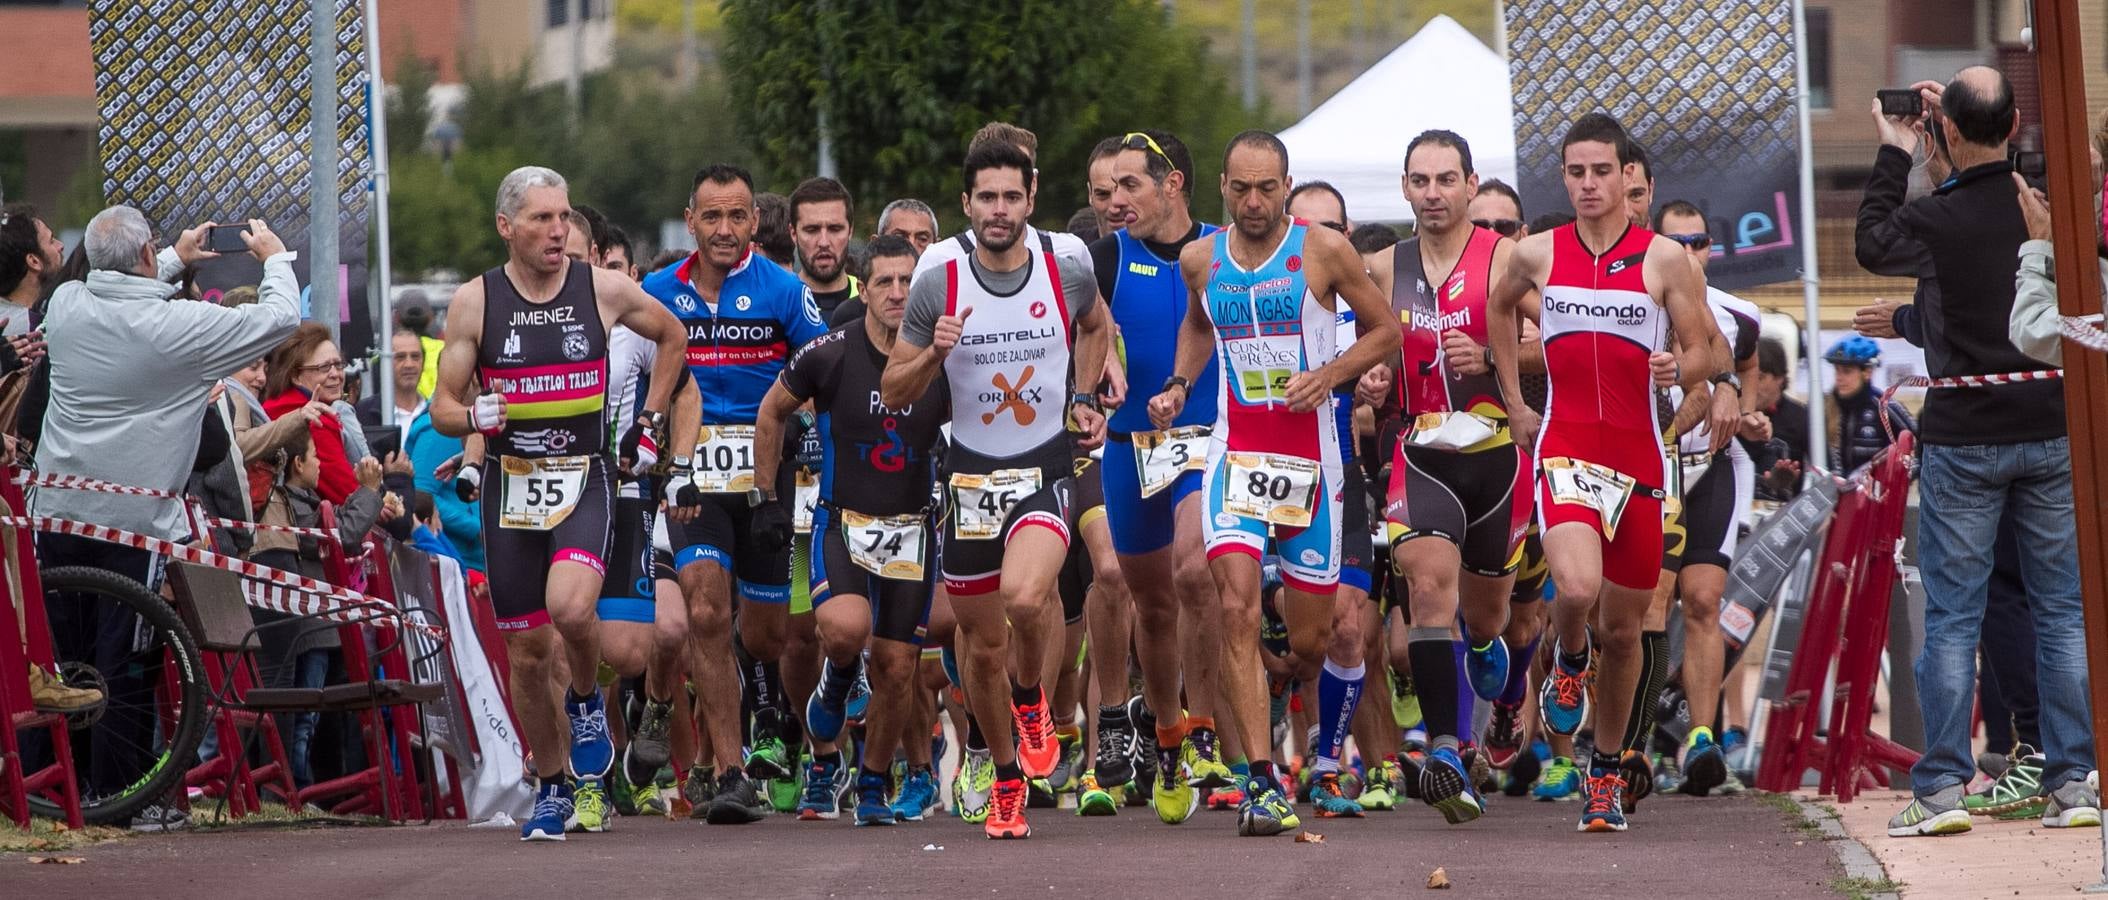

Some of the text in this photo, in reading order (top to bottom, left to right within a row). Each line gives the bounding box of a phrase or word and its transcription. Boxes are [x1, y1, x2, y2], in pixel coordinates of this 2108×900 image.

[114, 4, 143, 32] scm
[157, 0, 186, 28] scm
[168, 10, 197, 38] scm
[211, 6, 235, 34] scm
[246, 4, 268, 30] scm
[252, 14, 276, 41] scm
[281, 0, 308, 28] scm
[123, 14, 152, 42] scm
[133, 24, 161, 52] scm
[177, 20, 204, 48] scm
[220, 17, 242, 44] scm
[226, 27, 248, 54] scm
[261, 24, 284, 52] scm
[99, 38, 127, 66] scm
[142, 34, 170, 62] scm
[187, 30, 214, 58] scm
[195, 40, 222, 68] scm
[234, 37, 256, 64] scm
[267, 34, 292, 61] scm
[276, 44, 300, 71] scm
[108, 48, 136, 76] scm
[152, 44, 180, 72] scm
[161, 54, 190, 82] scm
[204, 50, 230, 78] scm
[241, 48, 264, 74] scm
[248, 58, 271, 84] scm
[283, 53, 309, 80] scm
[118, 58, 146, 86] scm
[126, 68, 154, 96] scm
[171, 64, 199, 92] scm
[211, 60, 235, 86] scm
[219, 70, 243, 97] scm
[255, 68, 277, 94] scm
[136, 78, 164, 106] scm
[180, 74, 206, 101] scm
[189, 84, 214, 111] scm
[225, 80, 250, 107] scm
[263, 78, 286, 104] scm
[270, 87, 293, 114] scm
[102, 92, 130, 119] scm
[110, 102, 138, 129] scm
[144, 88, 173, 116] scm
[154, 98, 183, 125] scm
[232, 90, 258, 116] scm
[278, 98, 302, 124] scm
[120, 112, 148, 139] scm
[163, 107, 190, 135] scm
[202, 104, 227, 131] scm
[245, 110, 273, 136] scm
[284, 106, 312, 134] scm
[128, 122, 156, 149] scm
[138, 131, 167, 159] scm
[174, 118, 198, 145] scm
[216, 124, 240, 150] scm
[251, 121, 280, 146] scm
[259, 132, 289, 156] scm
[343, 124, 368, 152] scm
[104, 145, 132, 172] scm
[147, 140, 176, 168] scm
[188, 137, 212, 164] scm
[194, 147, 218, 174] scm
[230, 143, 253, 170] scm
[265, 141, 294, 167] scm
[274, 151, 303, 176] scm
[112, 155, 140, 182] scm
[157, 151, 184, 178] scm
[201, 156, 226, 184] scm
[236, 152, 261, 180] scm
[244, 163, 269, 190] scm
[282, 160, 311, 188] scm
[123, 165, 151, 192] scm
[175, 171, 196, 198] scm
[215, 177, 239, 204] scm
[142, 184, 169, 210] scm
[187, 190, 210, 216] scm
[258, 183, 284, 209] scm
[1129, 263, 1158, 276] RAULY
[509, 306, 575, 326] JIMENEZ
[1217, 296, 1295, 324] MONAGAS
[711, 325, 773, 340] MOTOR
[691, 350, 727, 361] together
[729, 352, 740, 360] on
[742, 351, 757, 360] the
[974, 347, 1046, 365] SOLO DE ZALDIVAR
[696, 444, 754, 472] 101
[526, 478, 564, 507] 55
[1247, 470, 1293, 501] 80
[978, 488, 1021, 517] 46
[695, 547, 720, 559] Audi
[864, 529, 903, 556] 74
[167, 629, 194, 684] MERIDA
